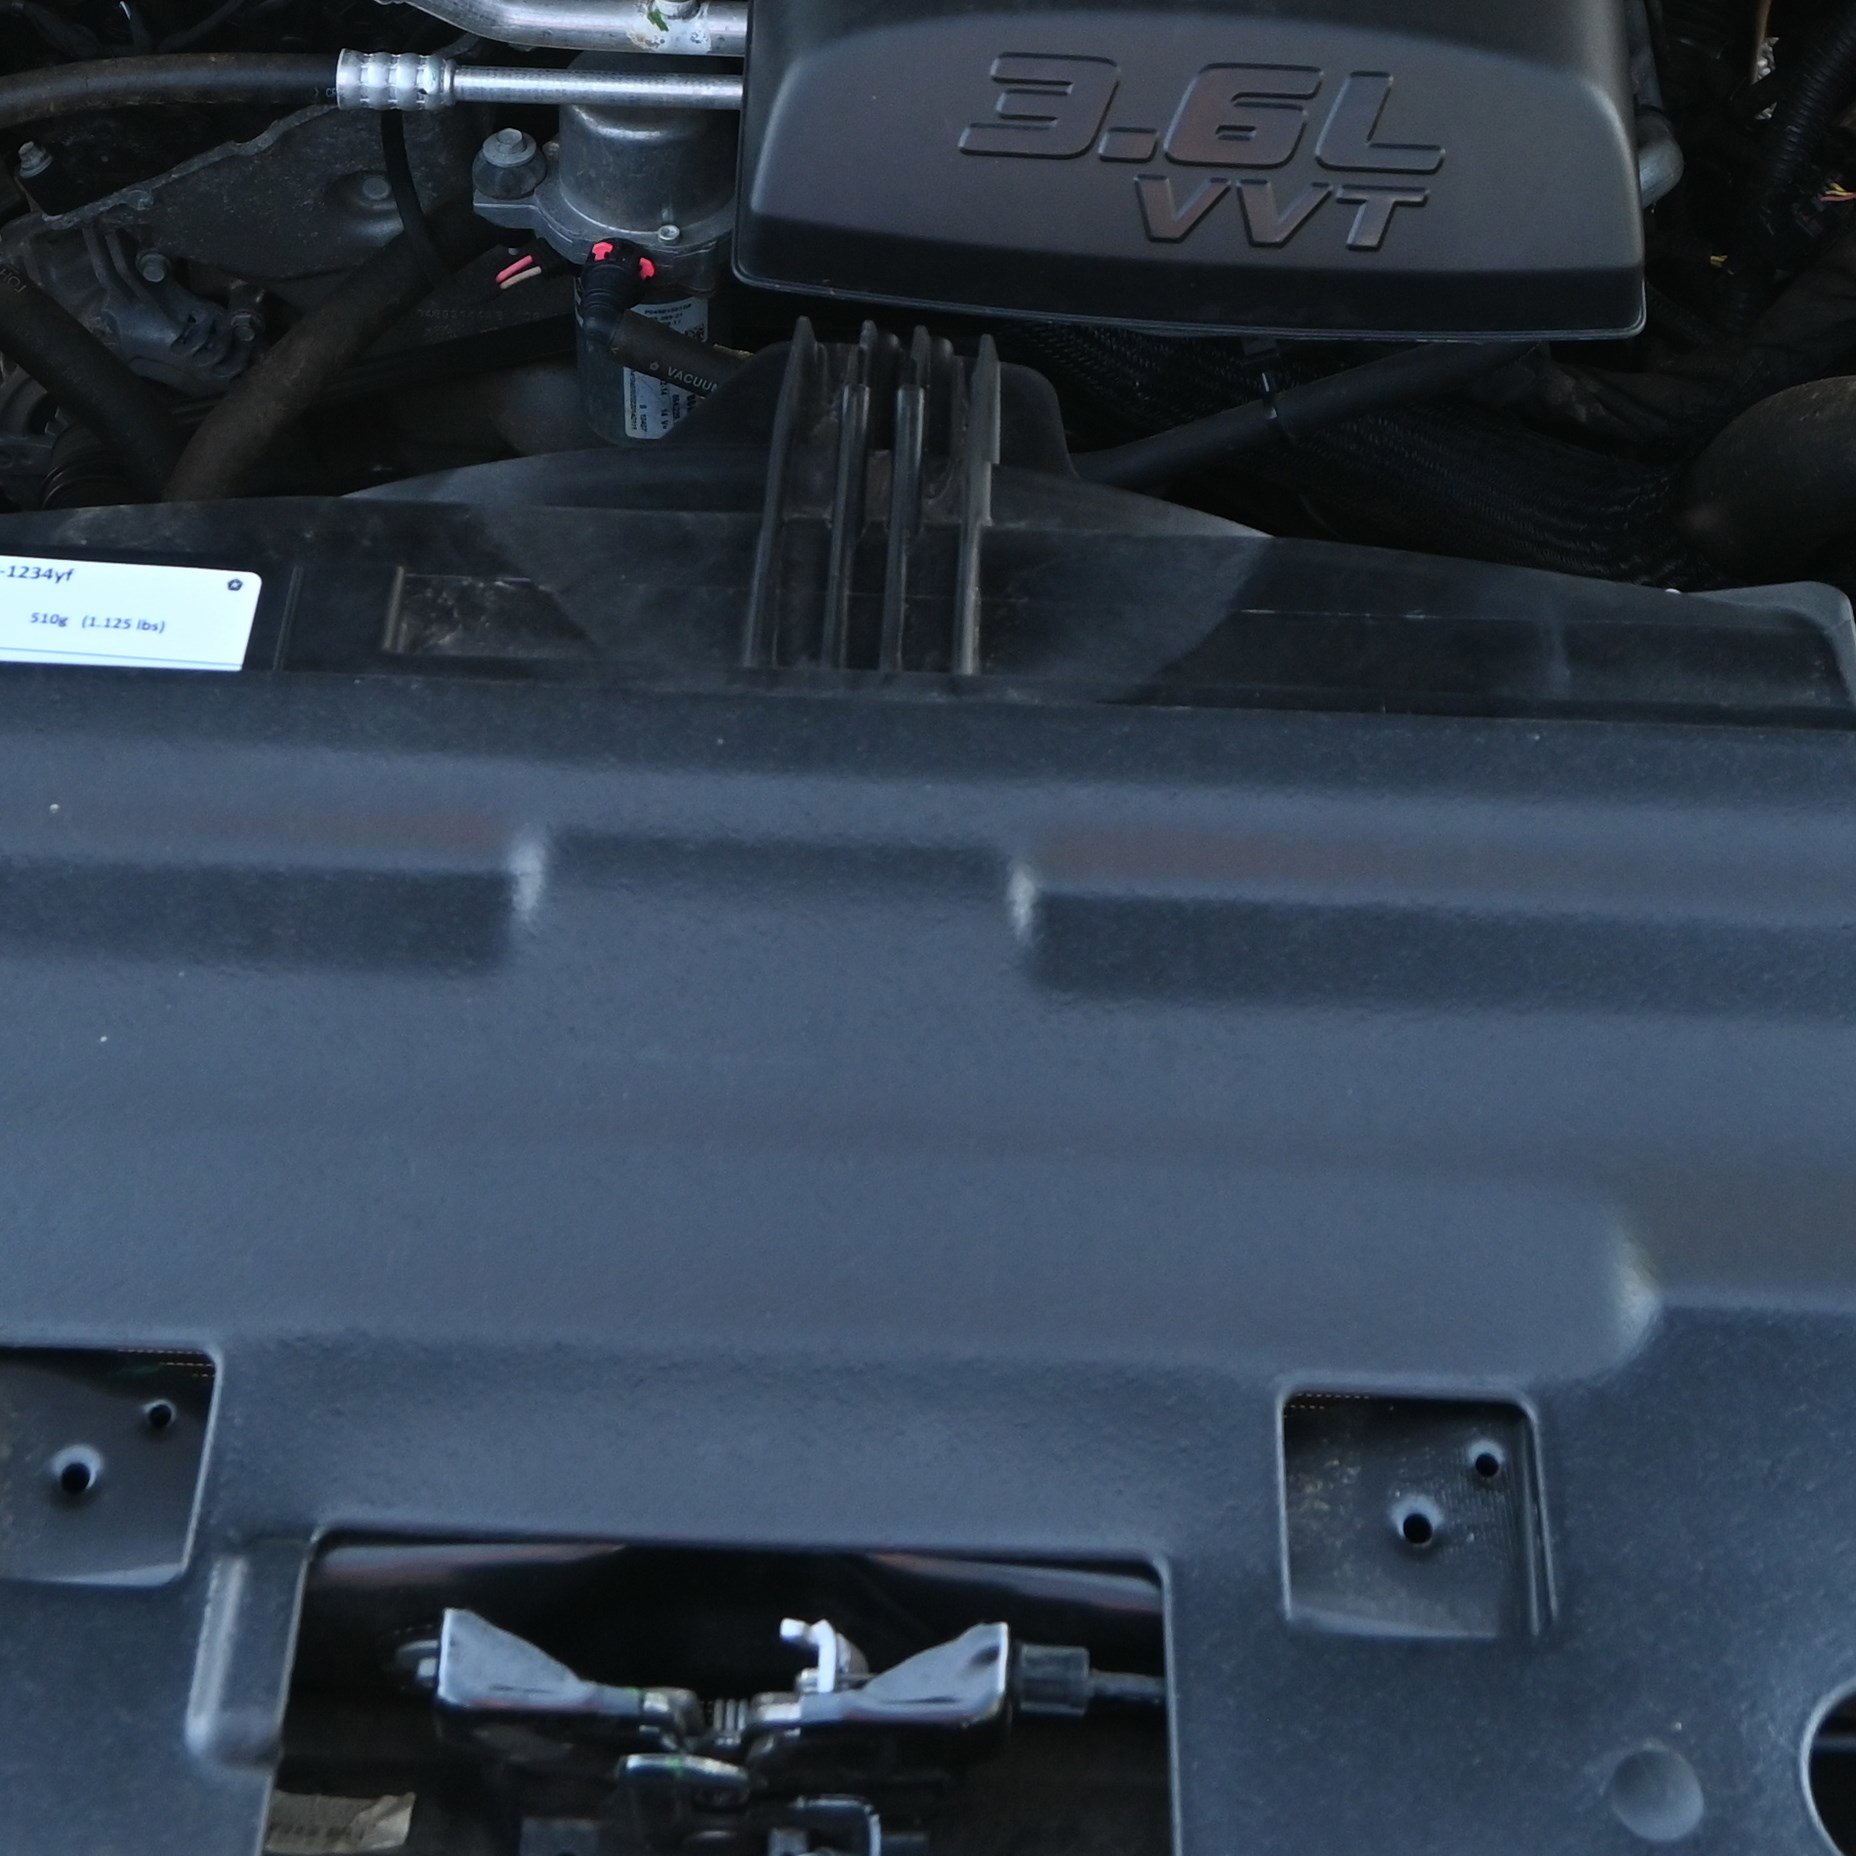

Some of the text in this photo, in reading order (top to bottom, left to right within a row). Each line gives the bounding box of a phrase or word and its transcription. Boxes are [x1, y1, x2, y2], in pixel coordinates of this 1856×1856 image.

[958, 51, 1445, 175] 3.6L
[1133, 174, 1431, 252] VVT
[31, 612, 167, 634] 510g (1.125 lbs)
